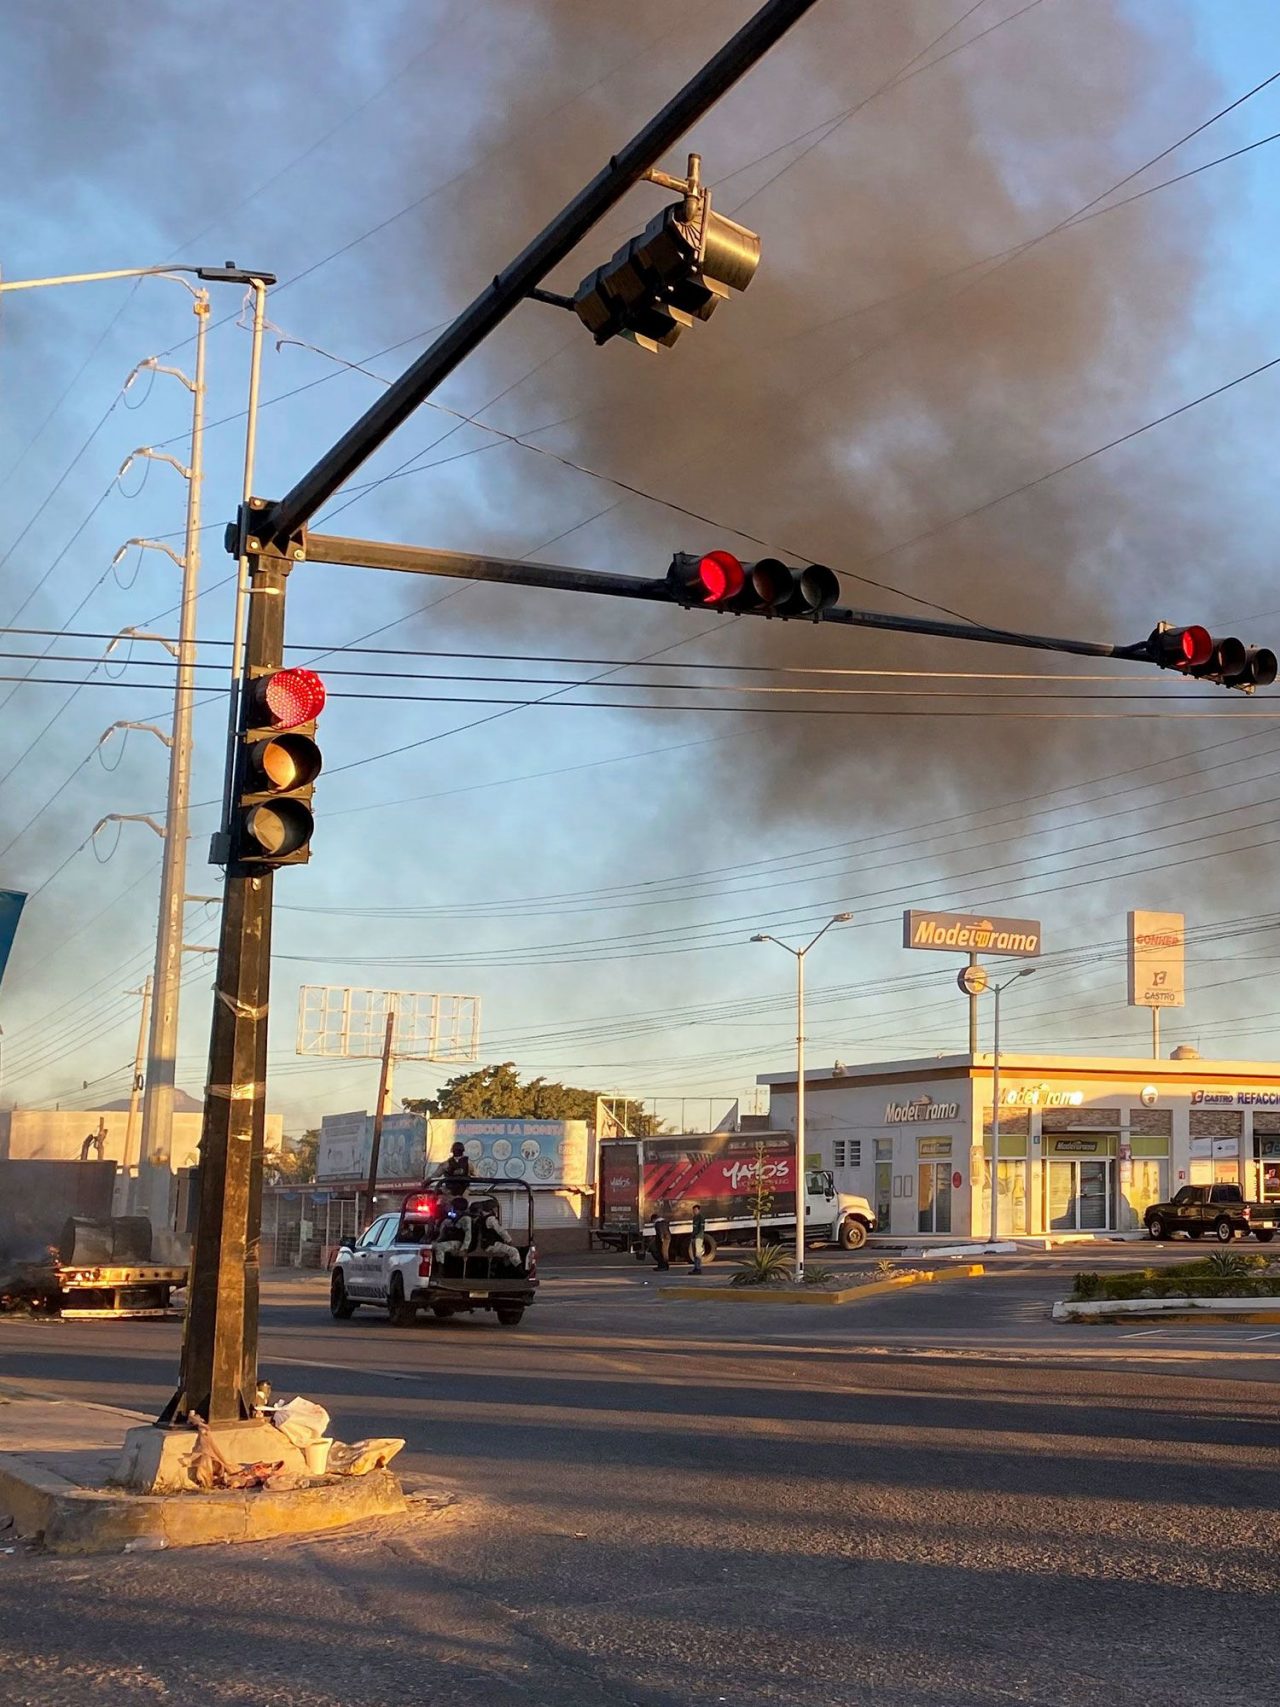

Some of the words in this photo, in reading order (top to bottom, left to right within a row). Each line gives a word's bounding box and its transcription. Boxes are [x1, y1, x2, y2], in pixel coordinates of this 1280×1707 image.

[914, 920, 1038, 951] Modelorama
[1144, 992, 1175, 1001] CASTRO
[1204, 1094, 1234, 1103] CASTRO
[884, 1100, 957, 1123] Modelorama
